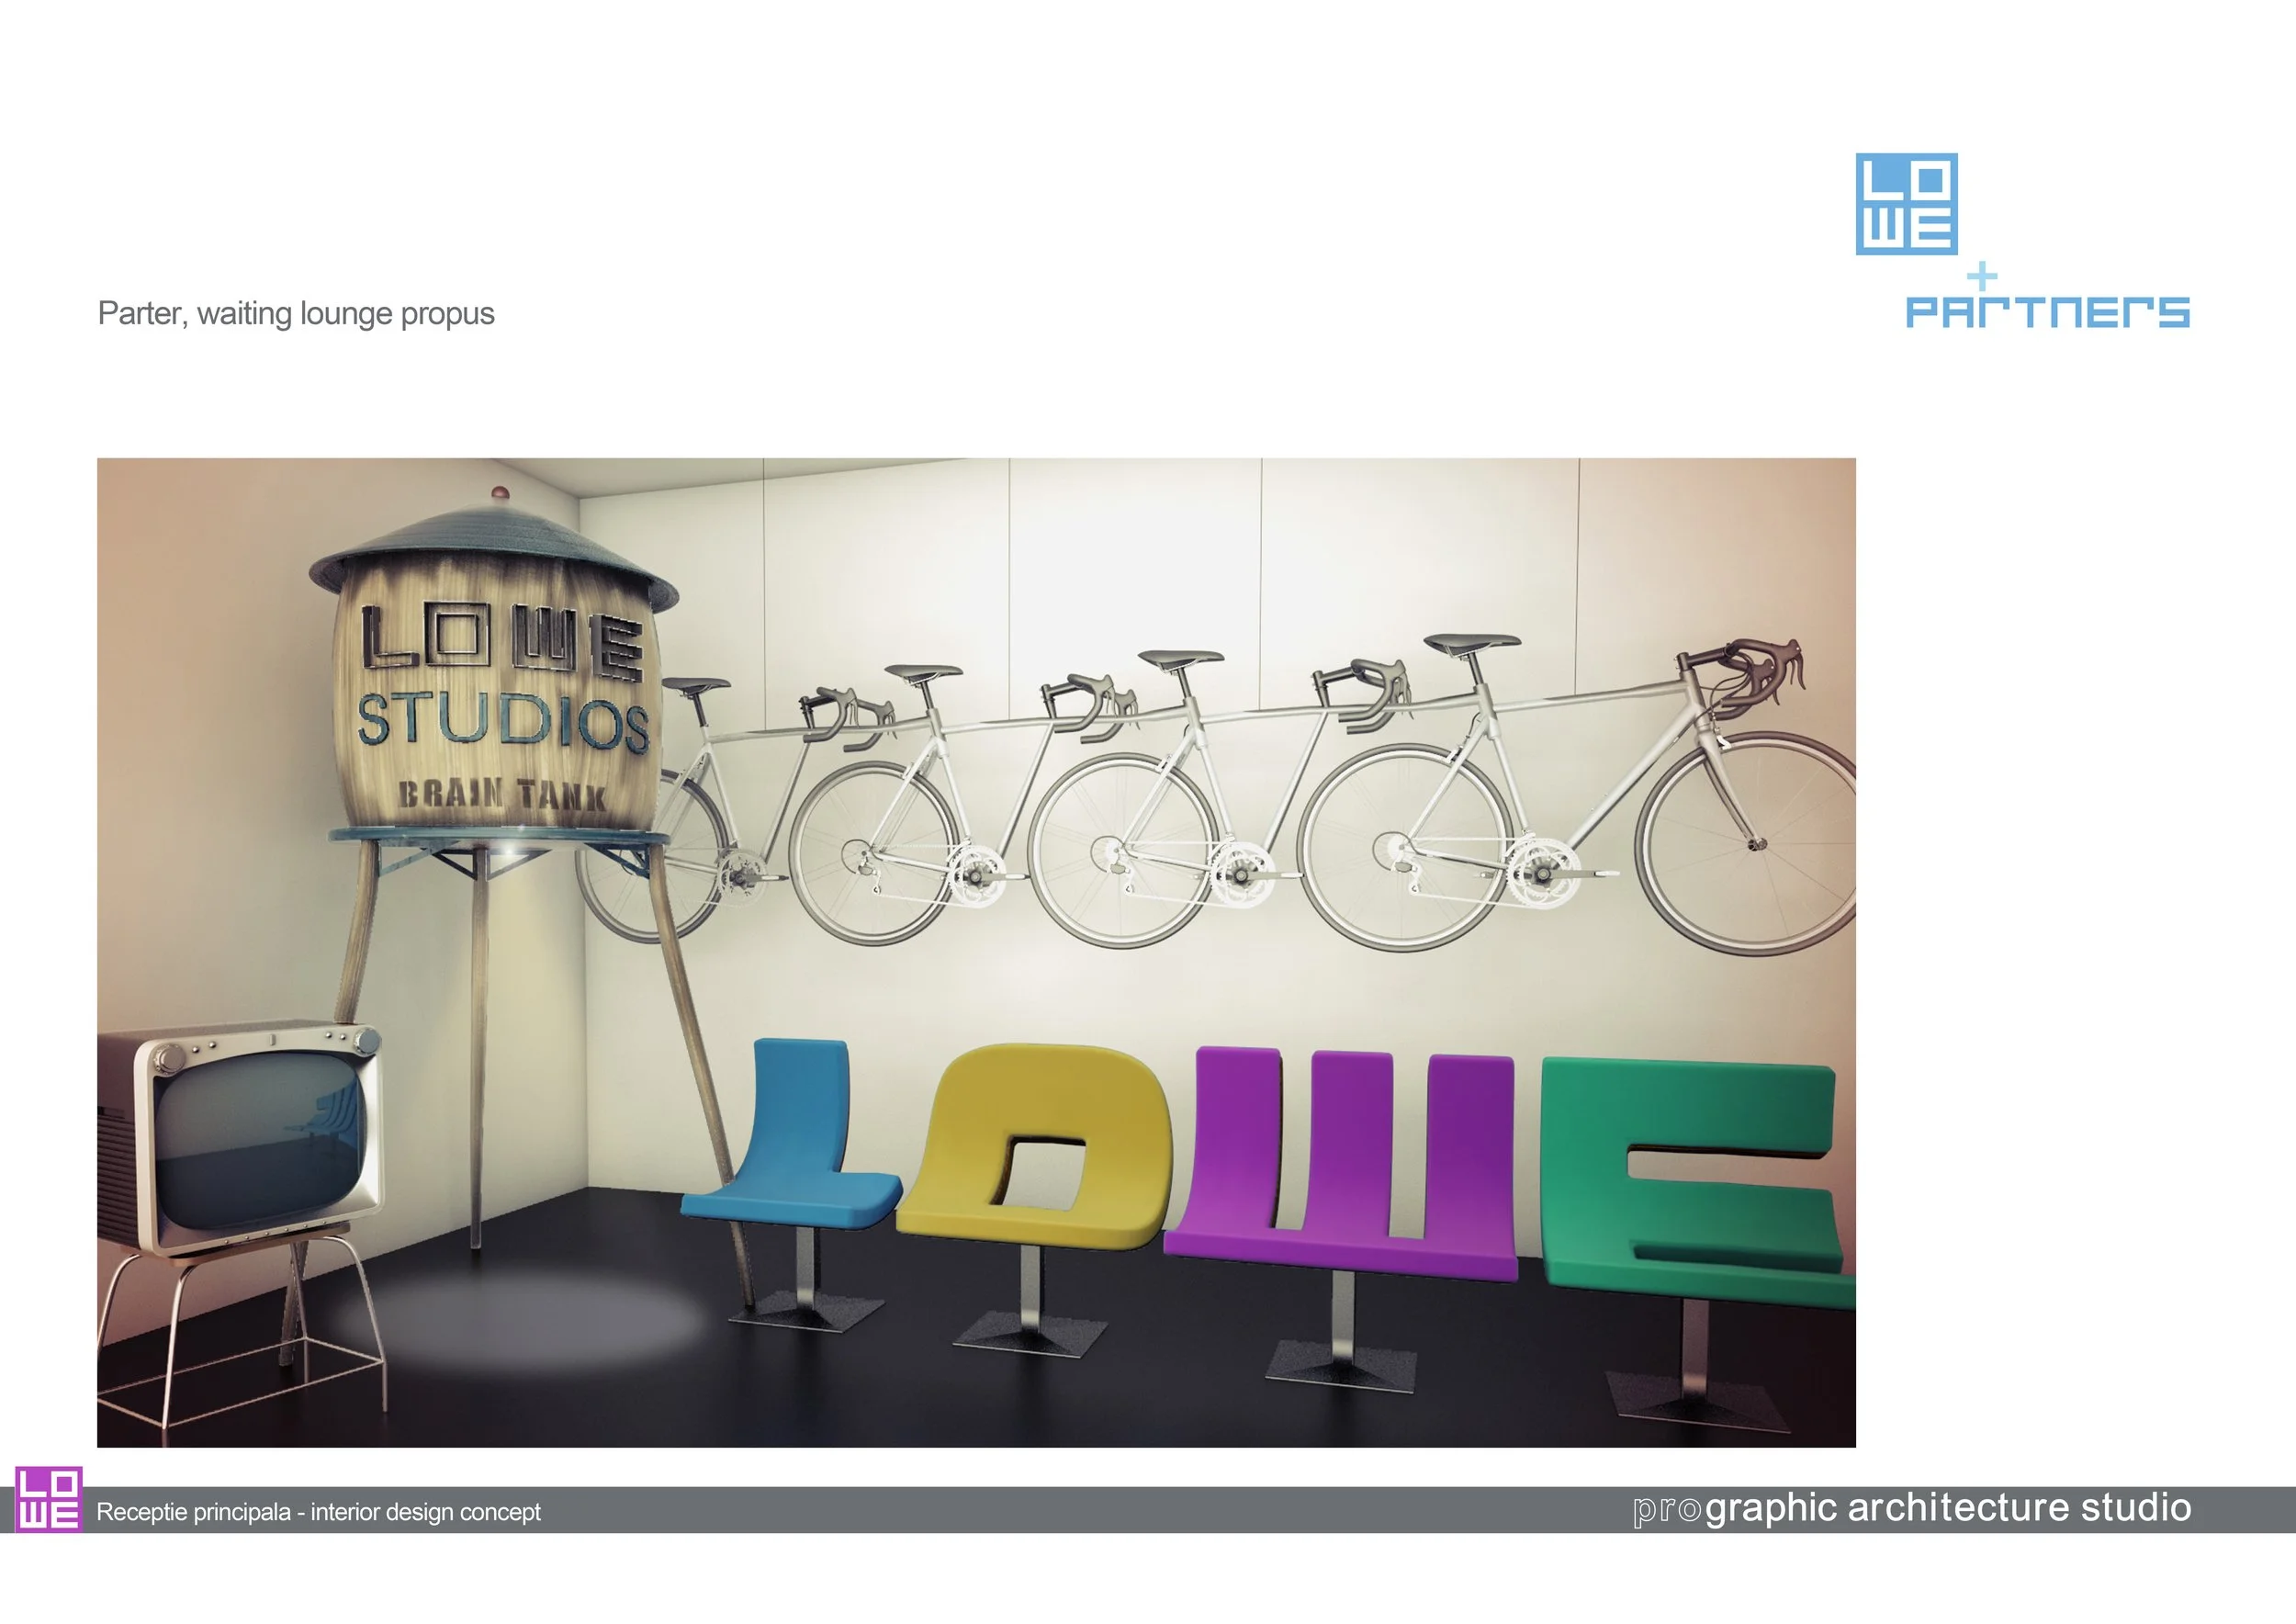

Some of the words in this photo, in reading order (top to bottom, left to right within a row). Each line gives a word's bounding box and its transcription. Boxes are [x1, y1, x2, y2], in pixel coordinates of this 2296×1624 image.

[362, 600, 644, 683] LOWE
[357, 691, 651, 757] STUDIOS
[398, 776, 503, 808] BRAIN
[516, 778, 608, 813] TANK
